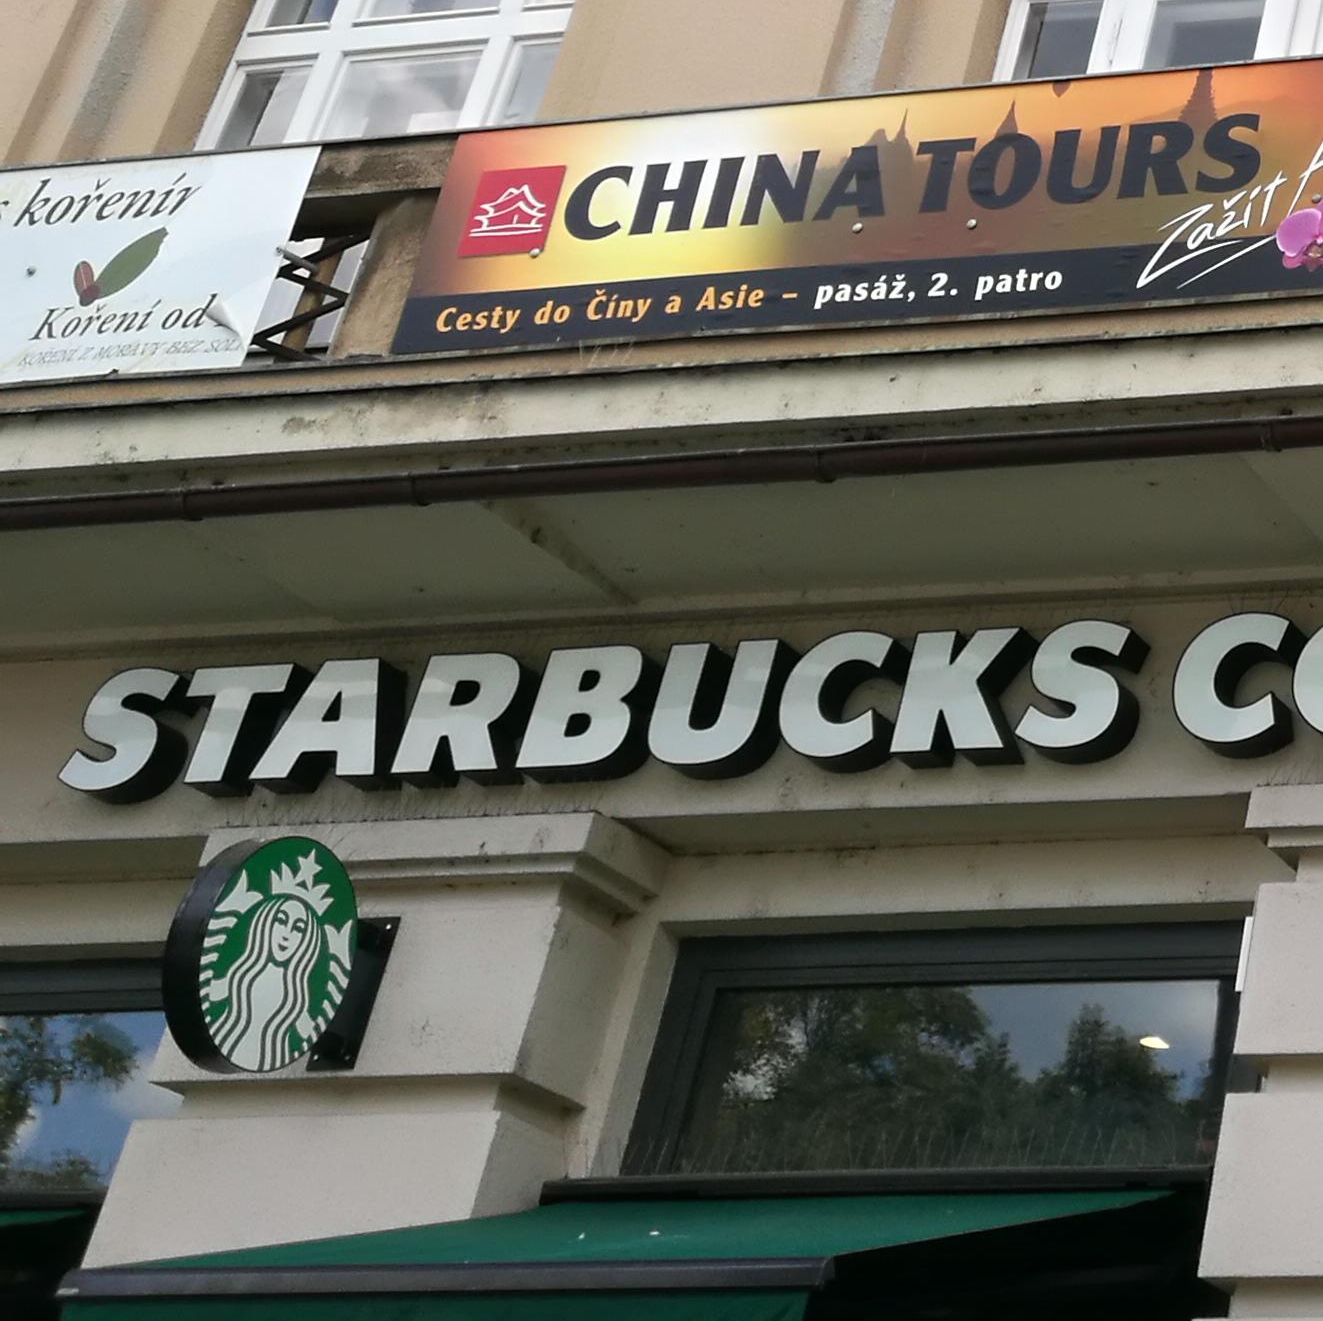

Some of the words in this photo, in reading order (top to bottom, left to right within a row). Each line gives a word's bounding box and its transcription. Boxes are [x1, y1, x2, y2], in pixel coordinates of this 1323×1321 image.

[564, 145, 885, 240] CHINA
[916, 113, 1262, 215] TOURS
[28, 299, 162, 340] Koření
[436, 307, 520, 333] Cesty
[534, 300, 571, 324] do
[586, 290, 652, 322] Číny
[664, 294, 682, 314] a
[696, 284, 765, 311] Asie
[813, 274, 915, 310] pasáž,
[927, 273, 958, 297] 2.
[974, 268, 1063, 301] patro
[58, 618, 1138, 798] STARBUCKS
